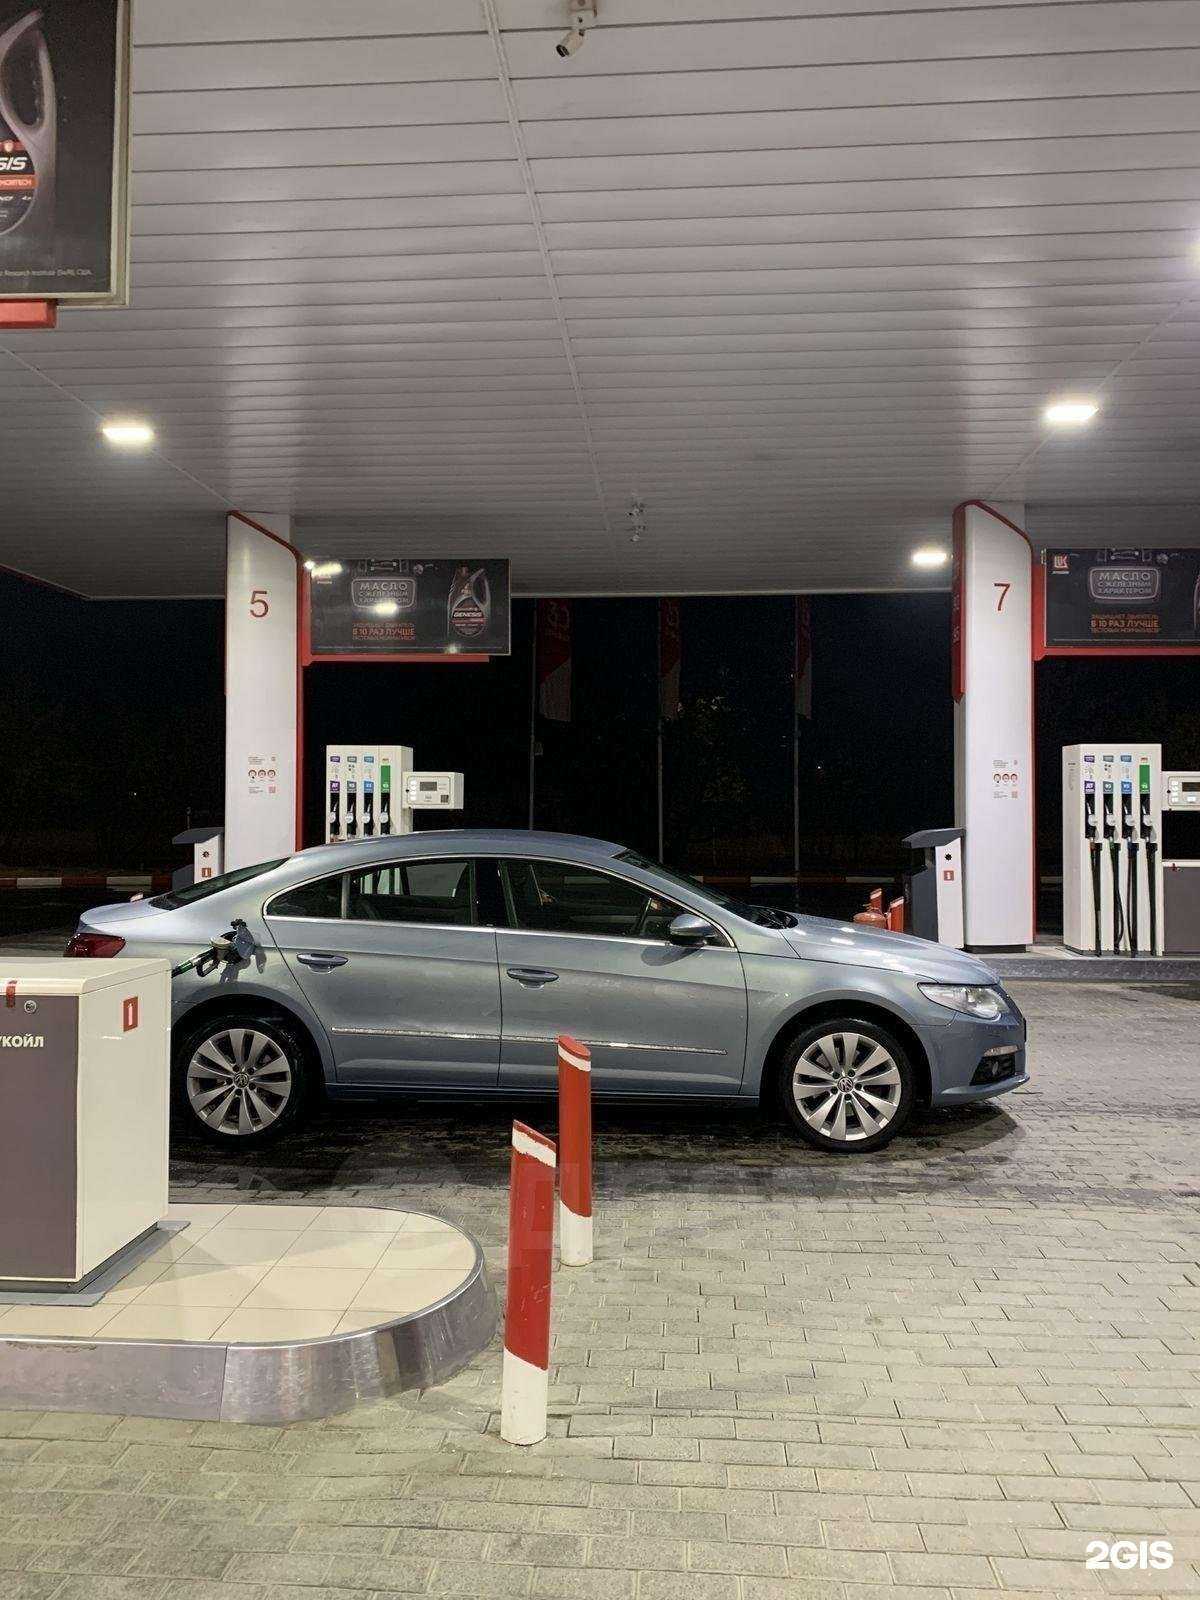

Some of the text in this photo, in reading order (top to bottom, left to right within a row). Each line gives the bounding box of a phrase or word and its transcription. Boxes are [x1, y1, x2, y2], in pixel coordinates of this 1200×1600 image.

[1099, 572, 1151, 581] МАСЛО
[359, 582, 408, 591] МАСЛО
[993, 582, 1011, 611] 7
[250, 590, 270, 618] 5
[1108, 619, 1125, 628] РАЗ
[1126, 619, 1158, 628] ЛУЧШЕ
[385, 628, 415, 636] ЛУЧШЕ
[0, 1033, 44, 1048] КОЙЛ
